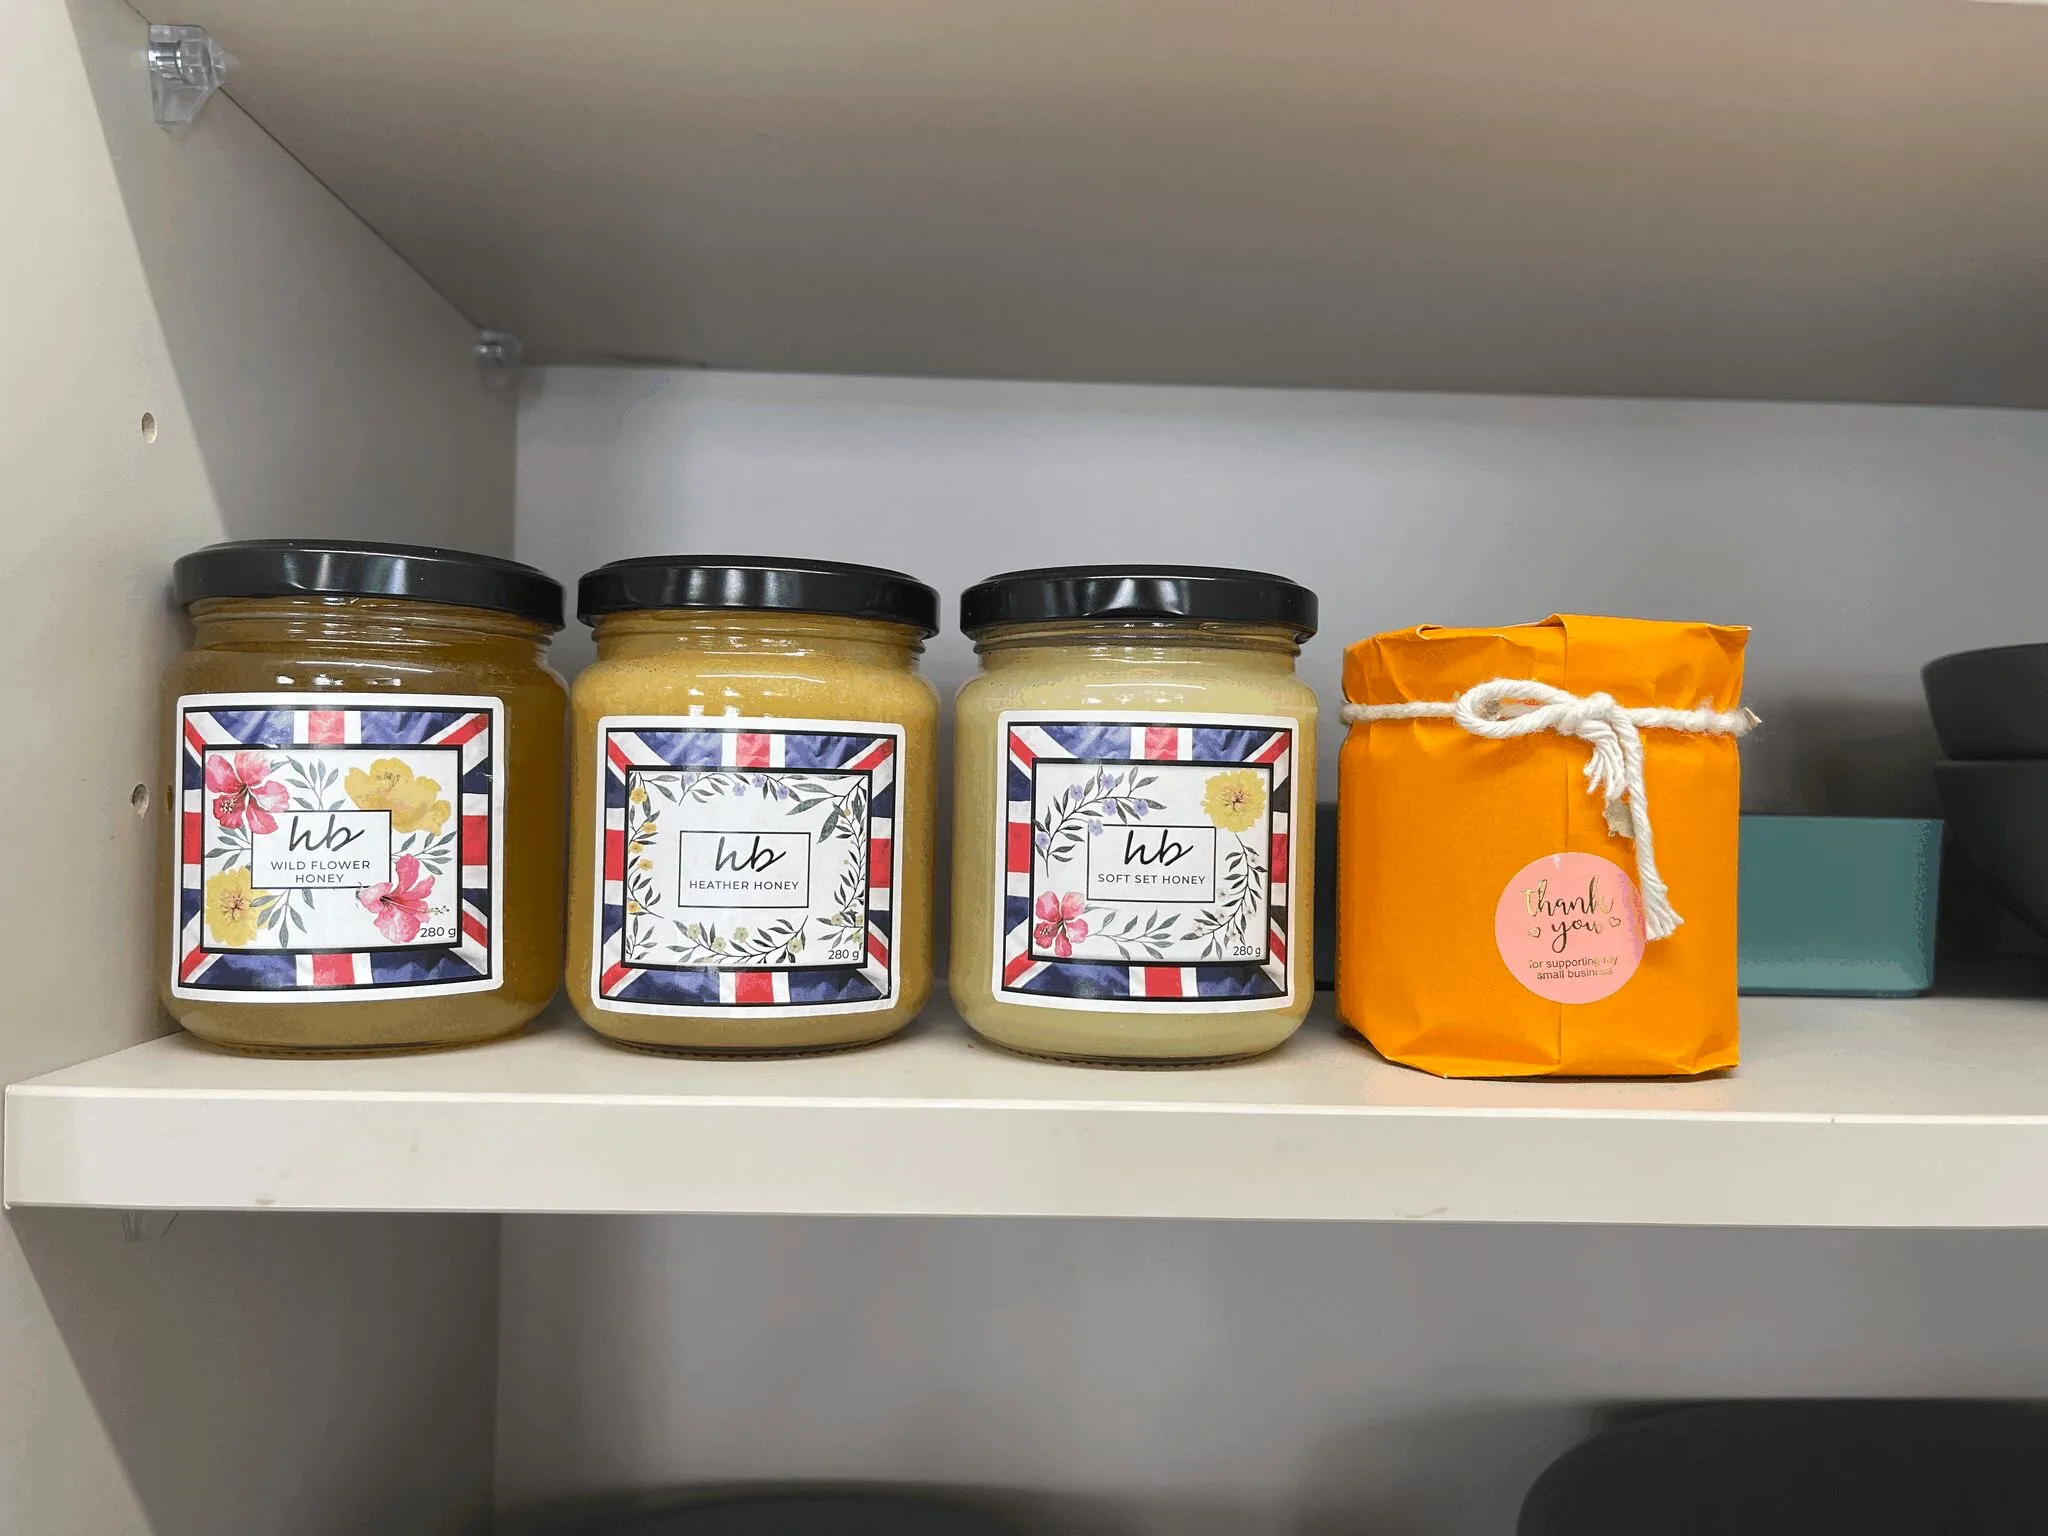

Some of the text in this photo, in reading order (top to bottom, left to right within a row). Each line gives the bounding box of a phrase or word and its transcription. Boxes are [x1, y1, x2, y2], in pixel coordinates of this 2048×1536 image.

[289, 814, 365, 852] hb
[715, 835, 787, 872] hb
[1124, 829, 1194, 867] hb
[270, 860, 371, 870] WILD FLOWER
[295, 874, 345, 883] HONEY
[1098, 873, 1206, 885] SOFT SET HONEY
[689, 880, 799, 891] HEATHER HONEY
[1520, 874, 1614, 917] thank
[420, 926, 457, 938] 280 g
[1551, 919, 1603, 953] you
[828, 949, 860, 960] 280 g
[1233, 945, 1262, 957] 280 g
[1529, 959, 1544, 969] for
[1546, 957, 1601, 969] supporting
[1536, 970, 1565, 980] small
